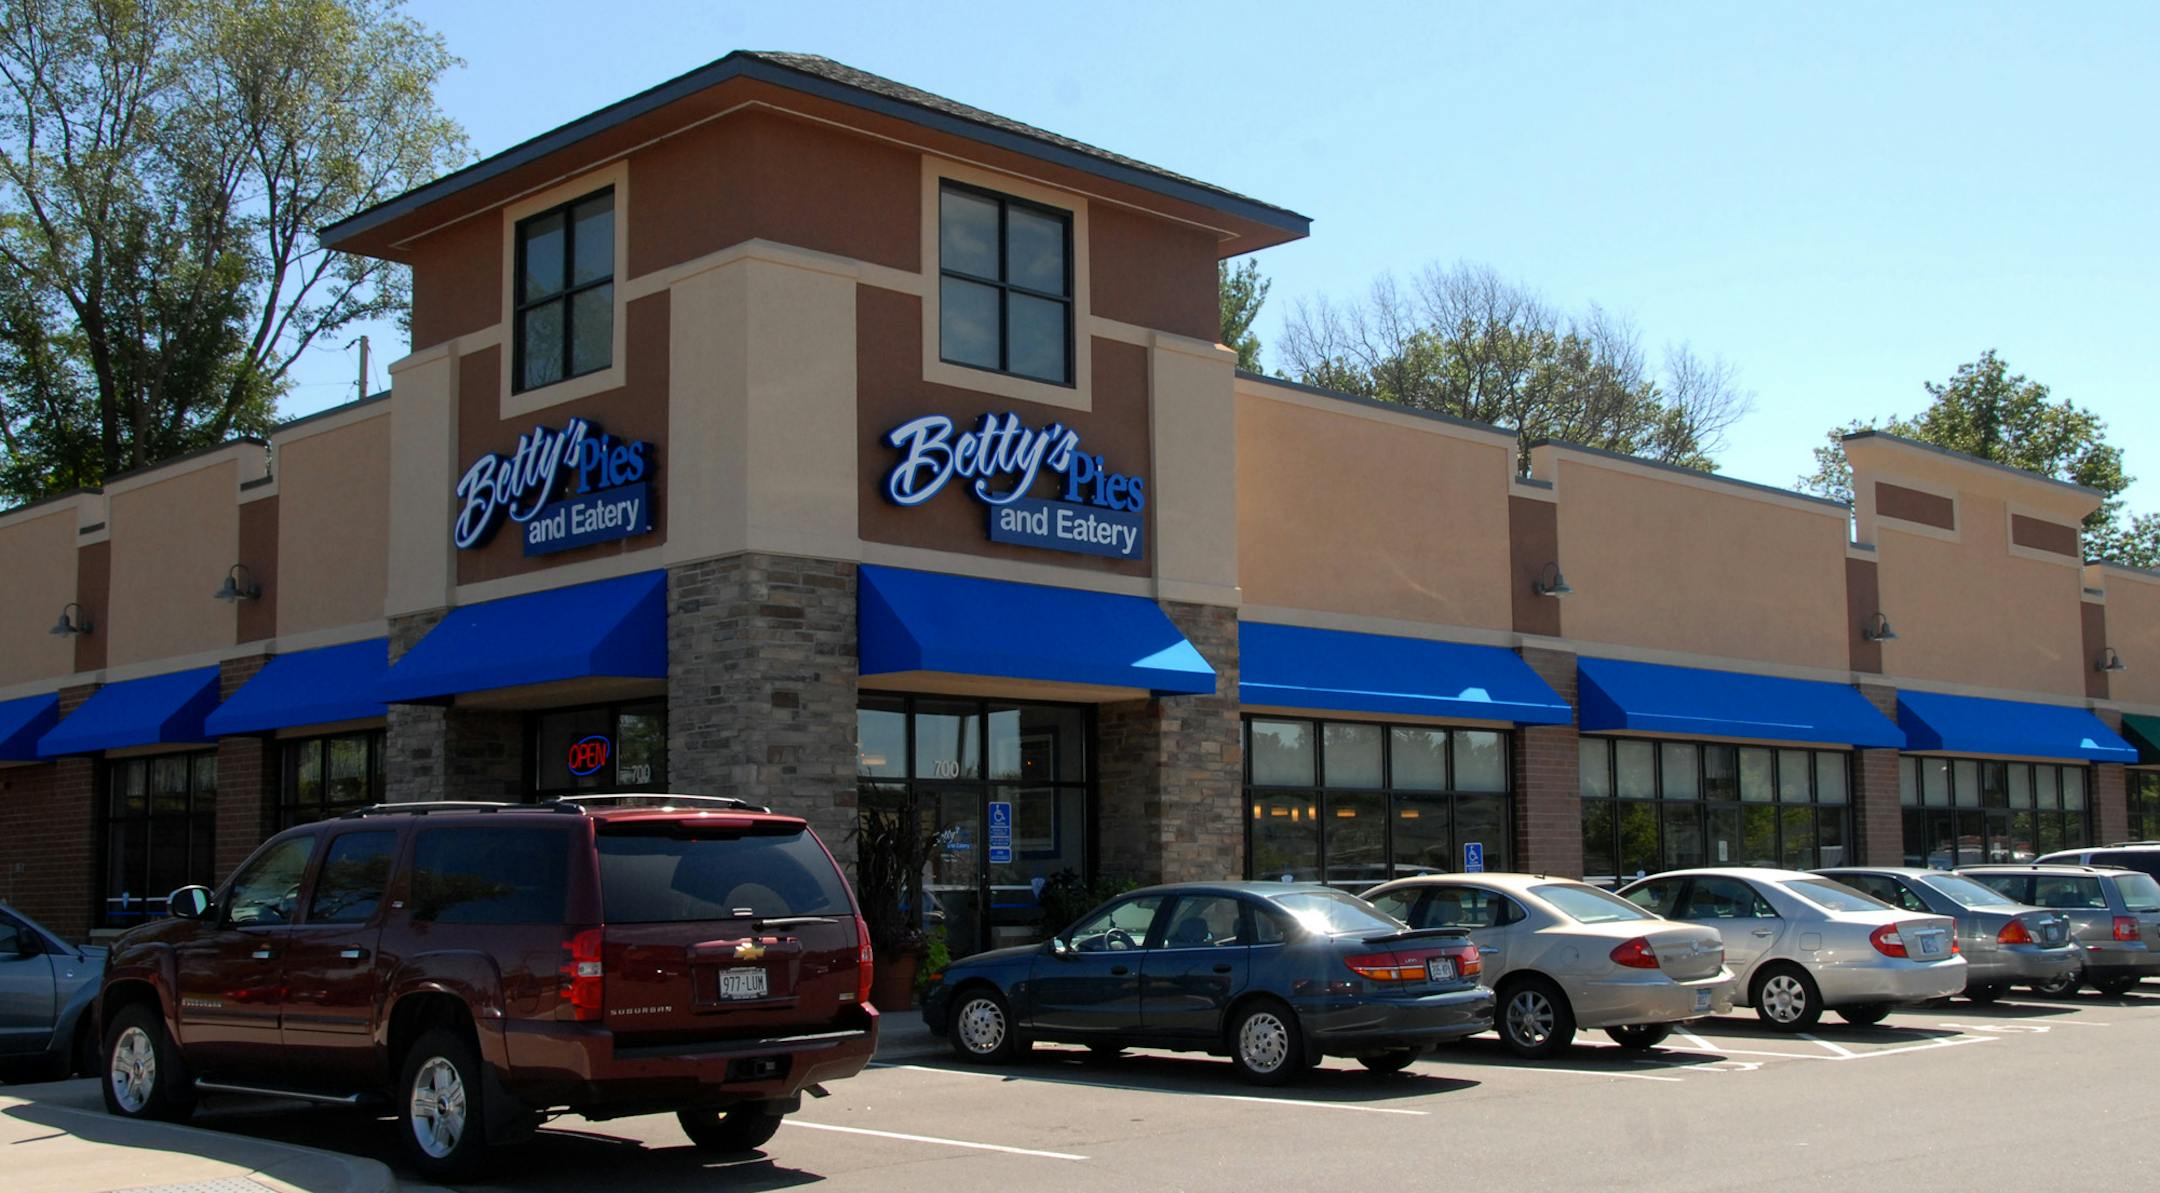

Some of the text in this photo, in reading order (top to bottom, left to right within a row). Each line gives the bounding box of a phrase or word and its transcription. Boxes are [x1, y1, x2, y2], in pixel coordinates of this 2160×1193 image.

[455, 416, 644, 548] Betty's Pies
[889, 411, 1146, 513] Betty's Pies
[528, 498, 640, 544] and Eatery
[1000, 506, 1138, 555] and Eatery
[568, 742, 607, 768] OPEN
[934, 760, 960, 779] 700
[610, 1006, 672, 1015] SUBURBAN
